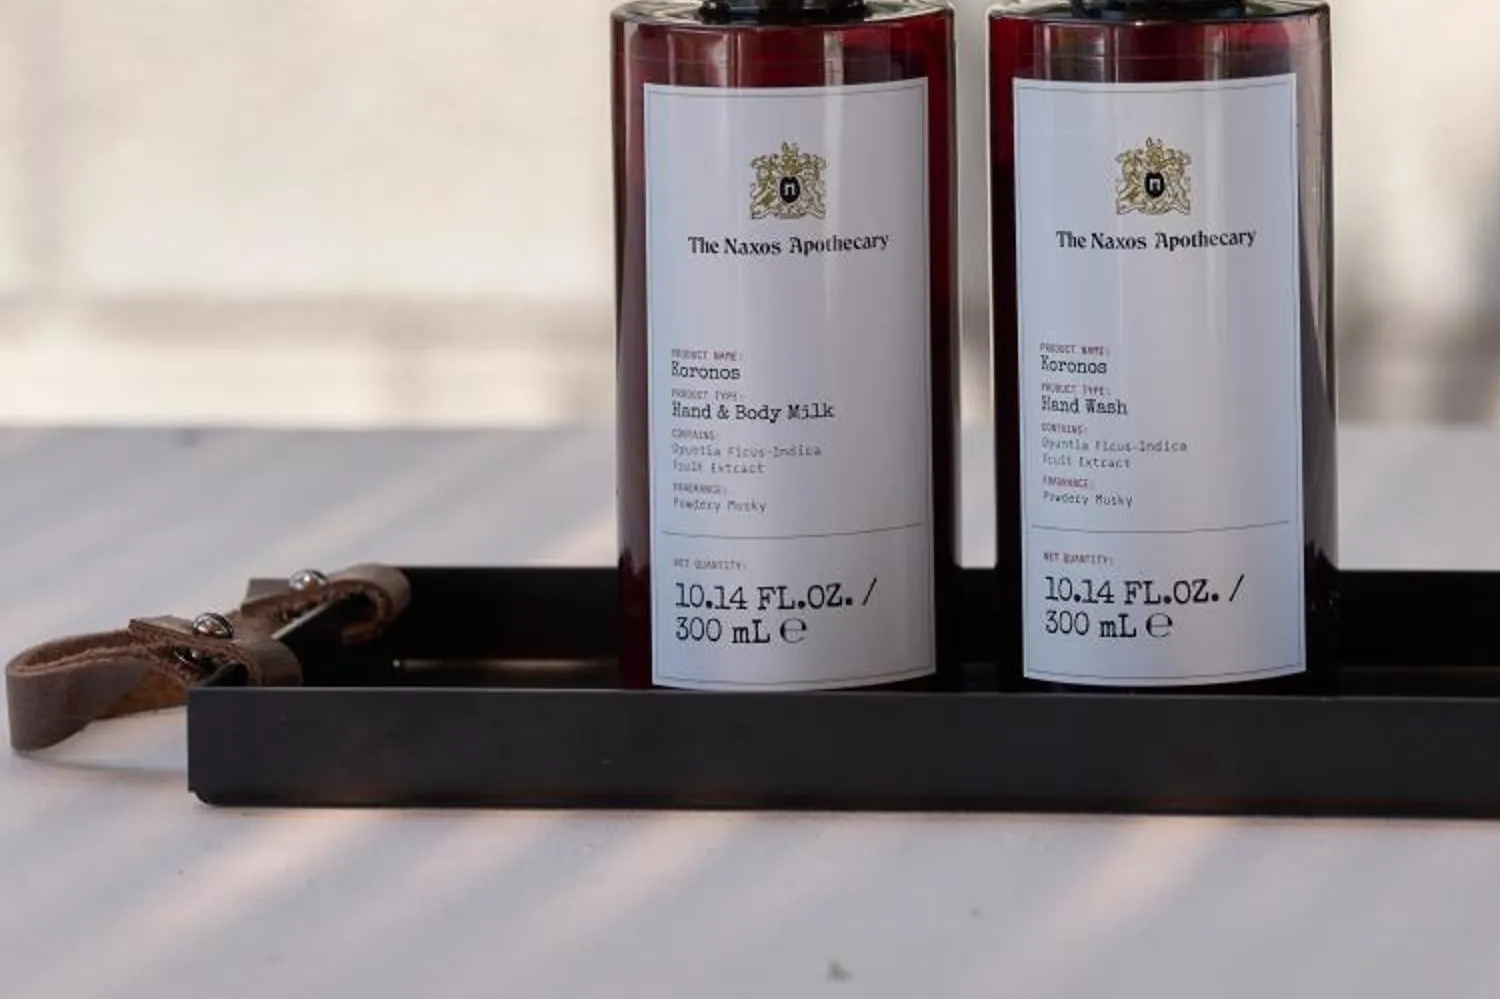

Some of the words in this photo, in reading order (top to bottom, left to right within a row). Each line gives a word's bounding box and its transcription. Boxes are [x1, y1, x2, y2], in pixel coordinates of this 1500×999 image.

[688, 236, 718, 254] The
[724, 237, 781, 255] Naxos
[789, 234, 889, 256] Apothecary
[1055, 231, 1087, 249] The
[1091, 232, 1147, 250] Naxos
[1154, 230, 1256, 251] Apothecary
[671, 361, 741, 380] Koronos
[1041, 355, 1107, 374] Koronos
[671, 402, 712, 420] Hand
[717, 404, 729, 420] &
[735, 404, 782, 423] Body
[787, 402, 834, 420] Milk
[1041, 395, 1080, 413] Hand
[1085, 398, 1128, 415] Wash
[711, 463, 767, 474] Extract
[1079, 457, 1131, 468] Extract
[675, 582, 748, 610] 10.14
[757, 583, 853, 610] FL.OZ.
[1045, 576, 1114, 605] 10.14
[1124, 578, 1220, 605] FL.OZ.
[675, 617, 722, 642] 300
[731, 618, 771, 644] mL
[1045, 610, 1090, 636] 300
[1099, 613, 1137, 638] mL
